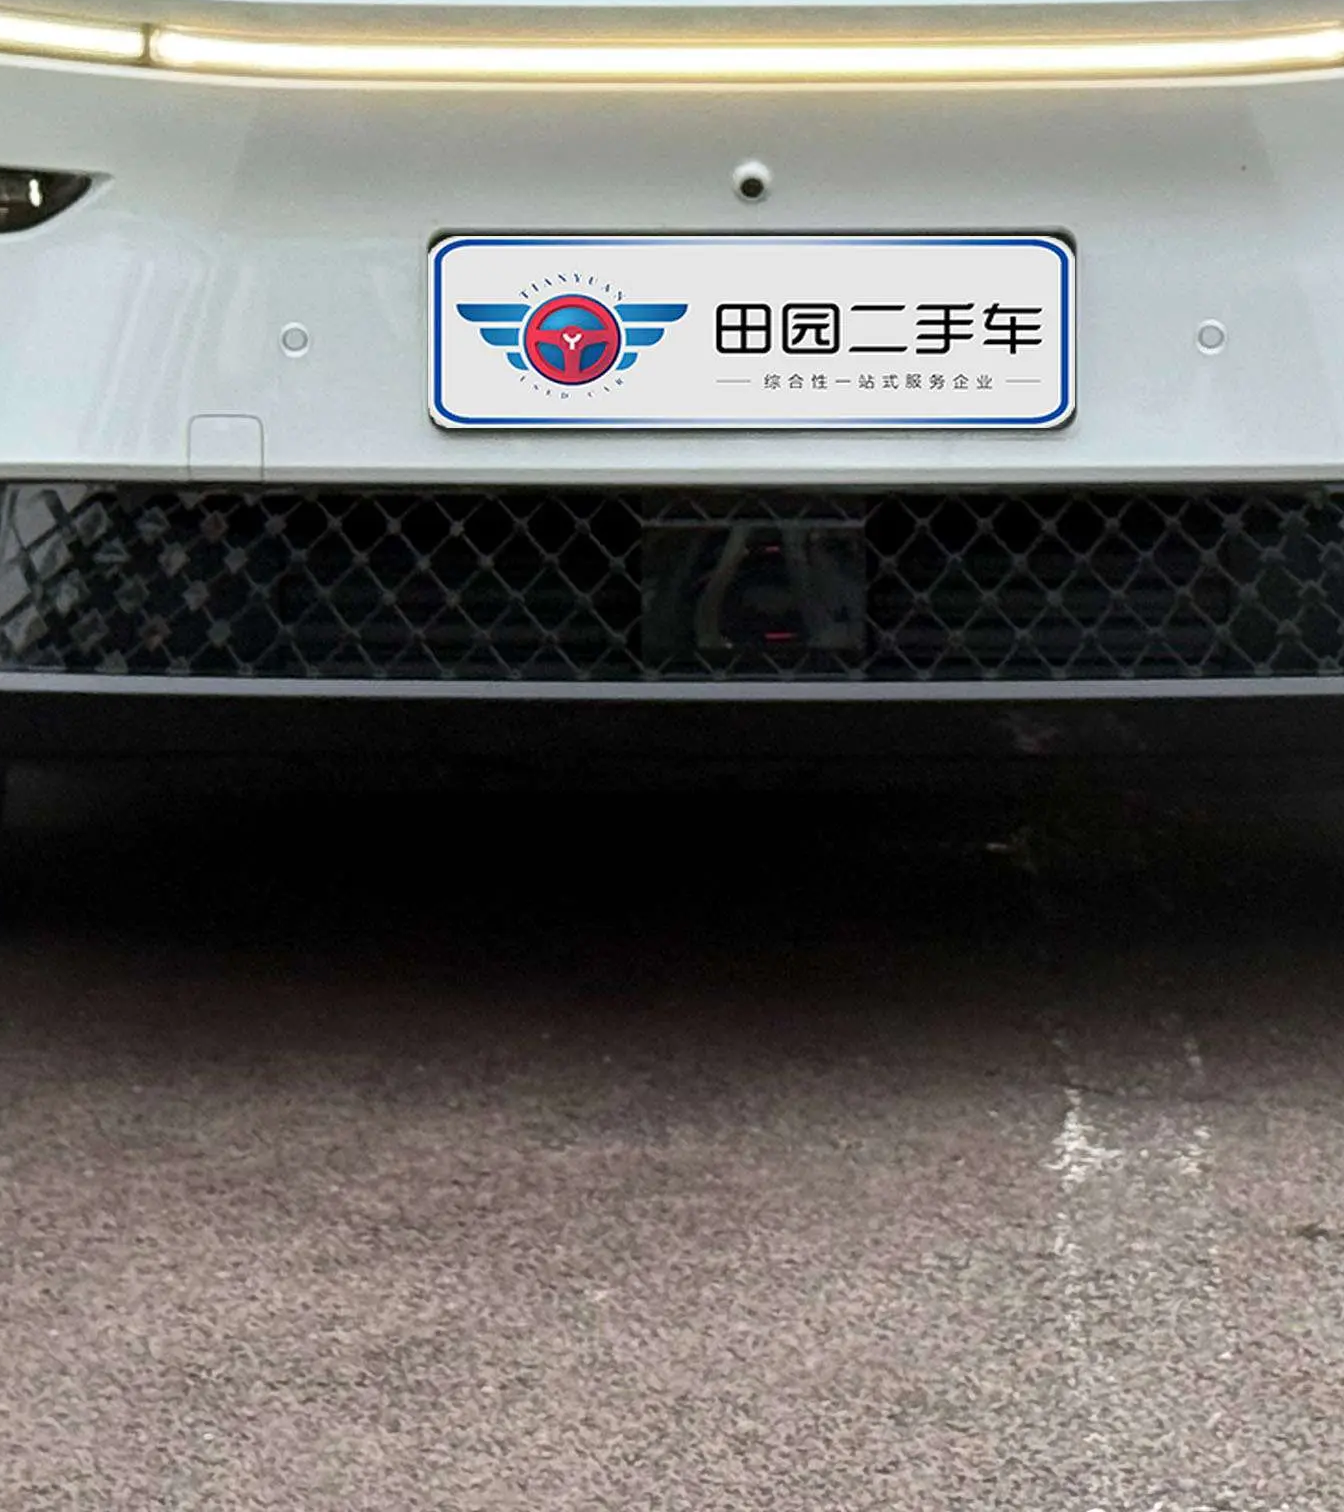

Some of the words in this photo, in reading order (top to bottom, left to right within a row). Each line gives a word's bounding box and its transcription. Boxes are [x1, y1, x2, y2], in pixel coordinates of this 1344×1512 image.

[716, 302, 1043, 355] 田园二手车
[763, 373, 993, 390] 综合性一站式服务企业
